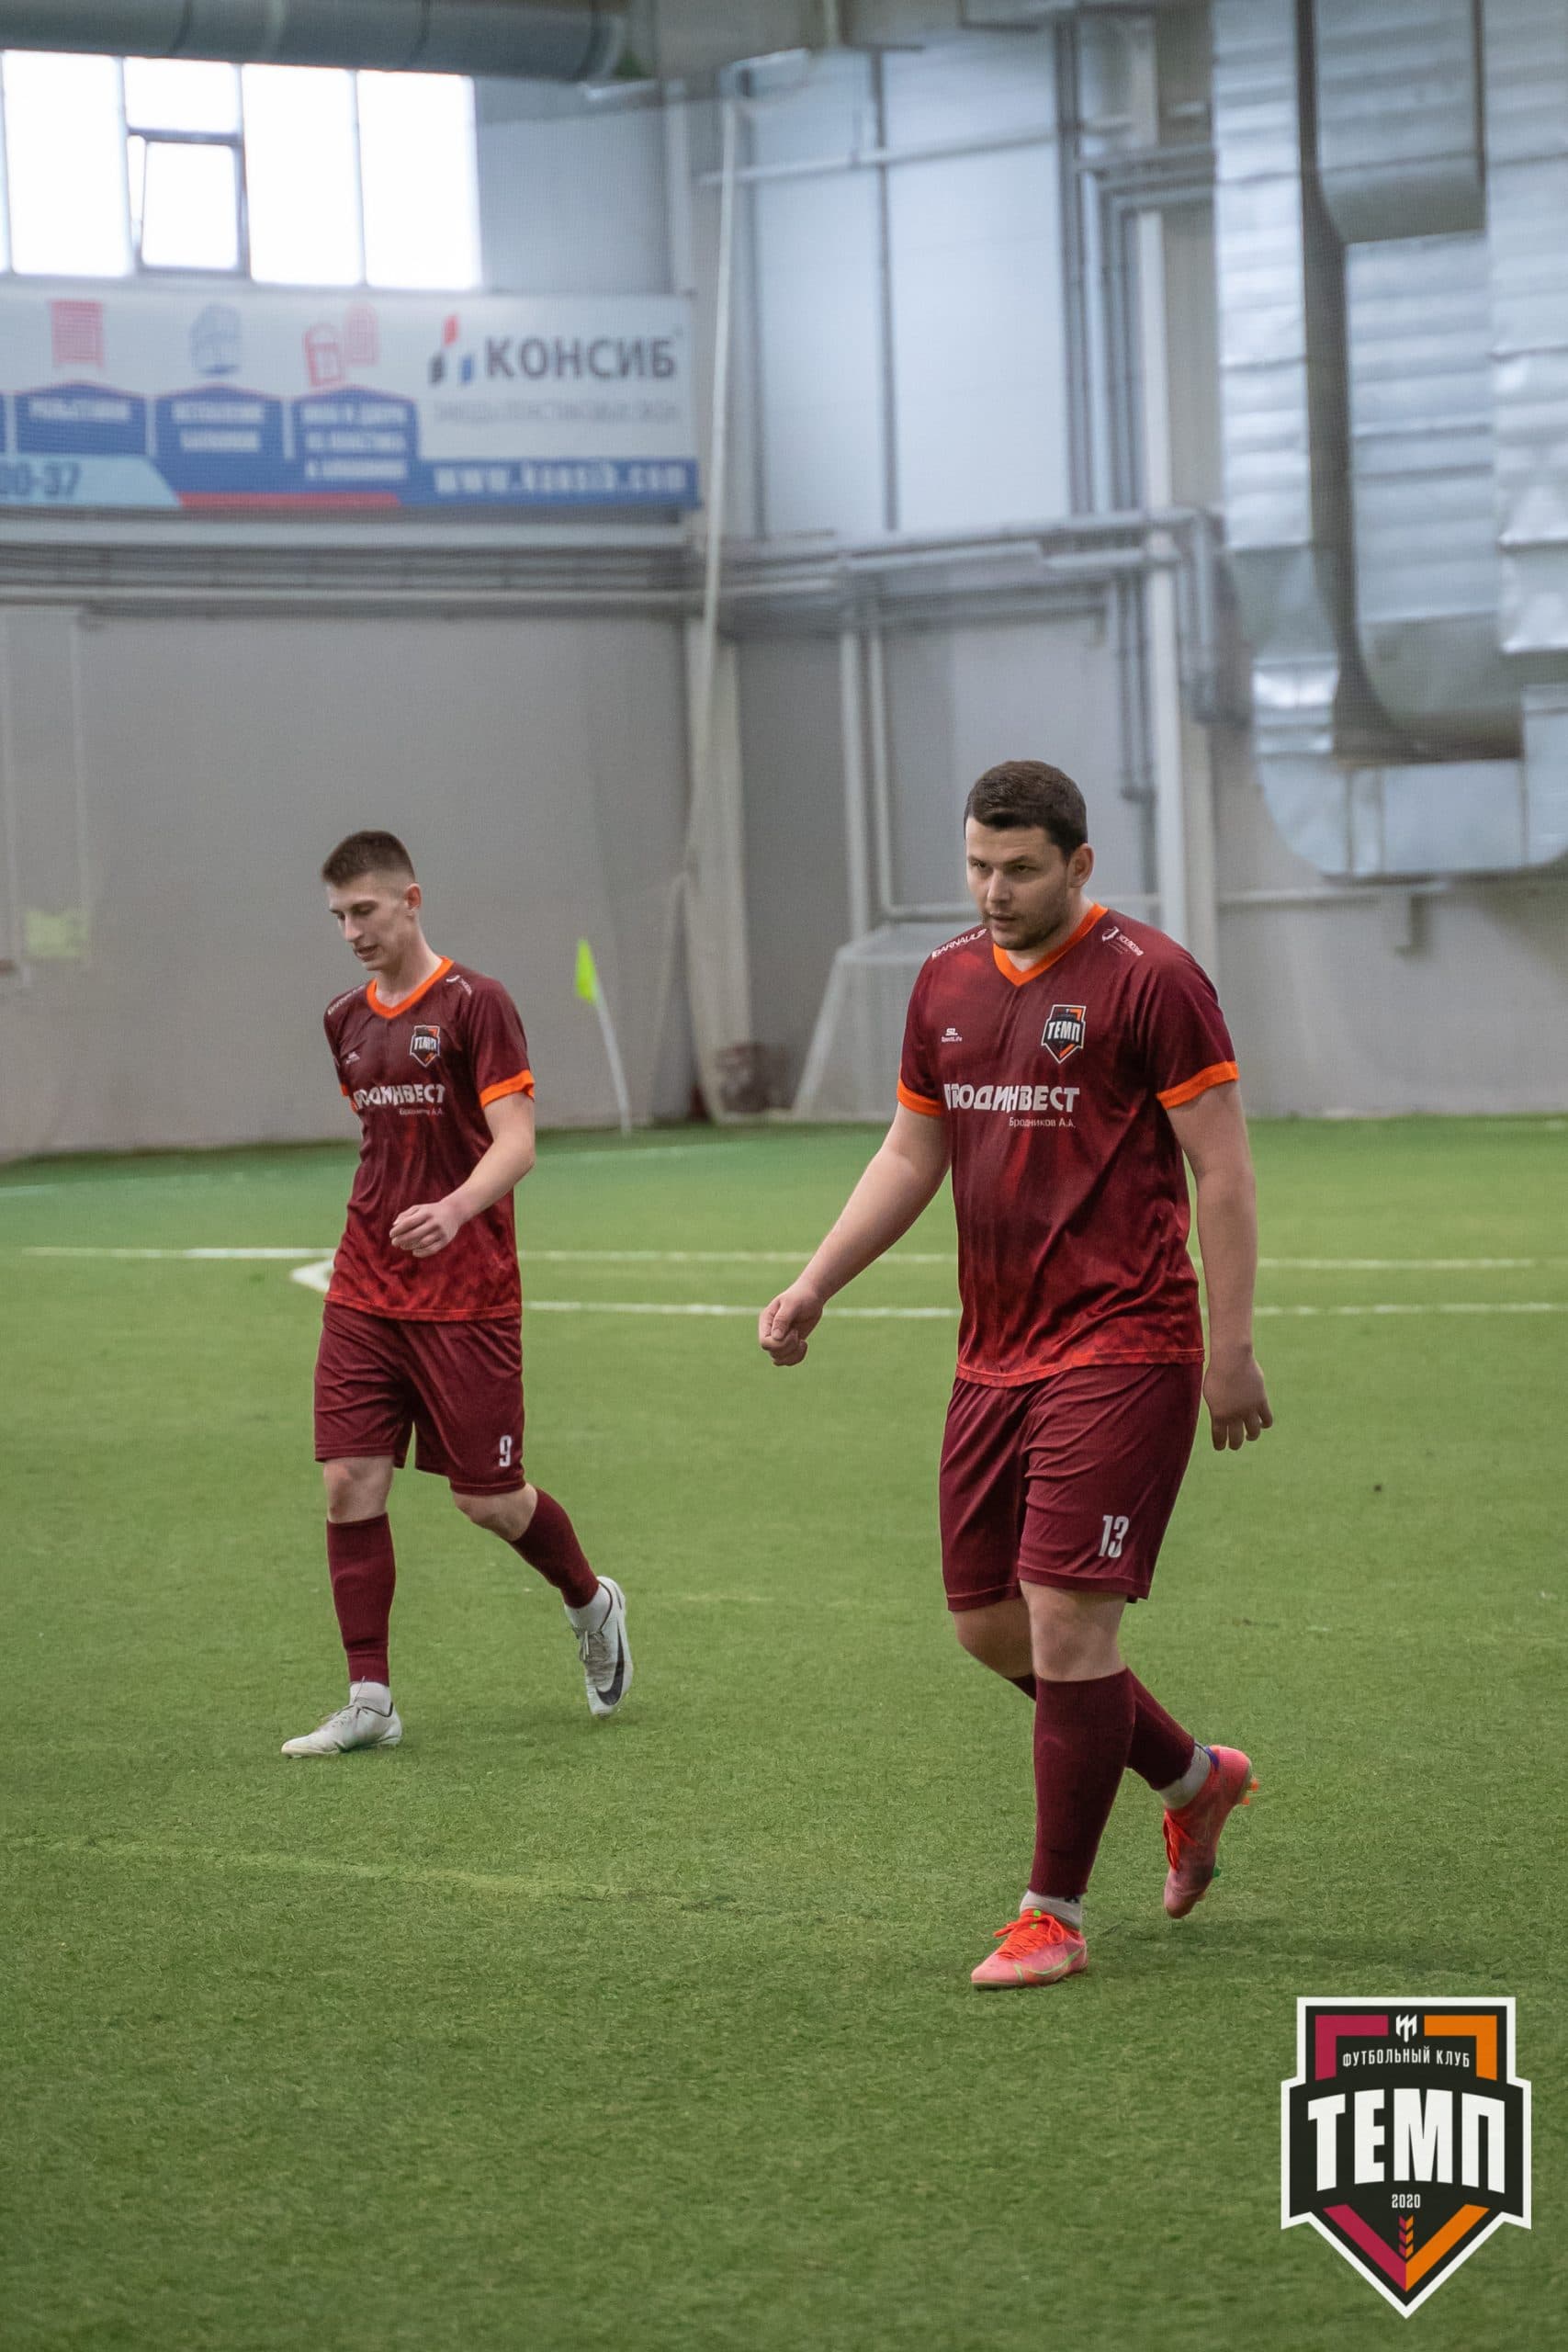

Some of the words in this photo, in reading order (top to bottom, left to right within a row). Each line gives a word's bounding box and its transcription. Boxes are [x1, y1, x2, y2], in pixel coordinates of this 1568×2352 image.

[486, 336, 676, 379] КОНСИБ
[1047, 1021, 1081, 1043] ТЕМП
[499, 1435, 513, 1467] 9
[1098, 1514, 1130, 1558] 13
